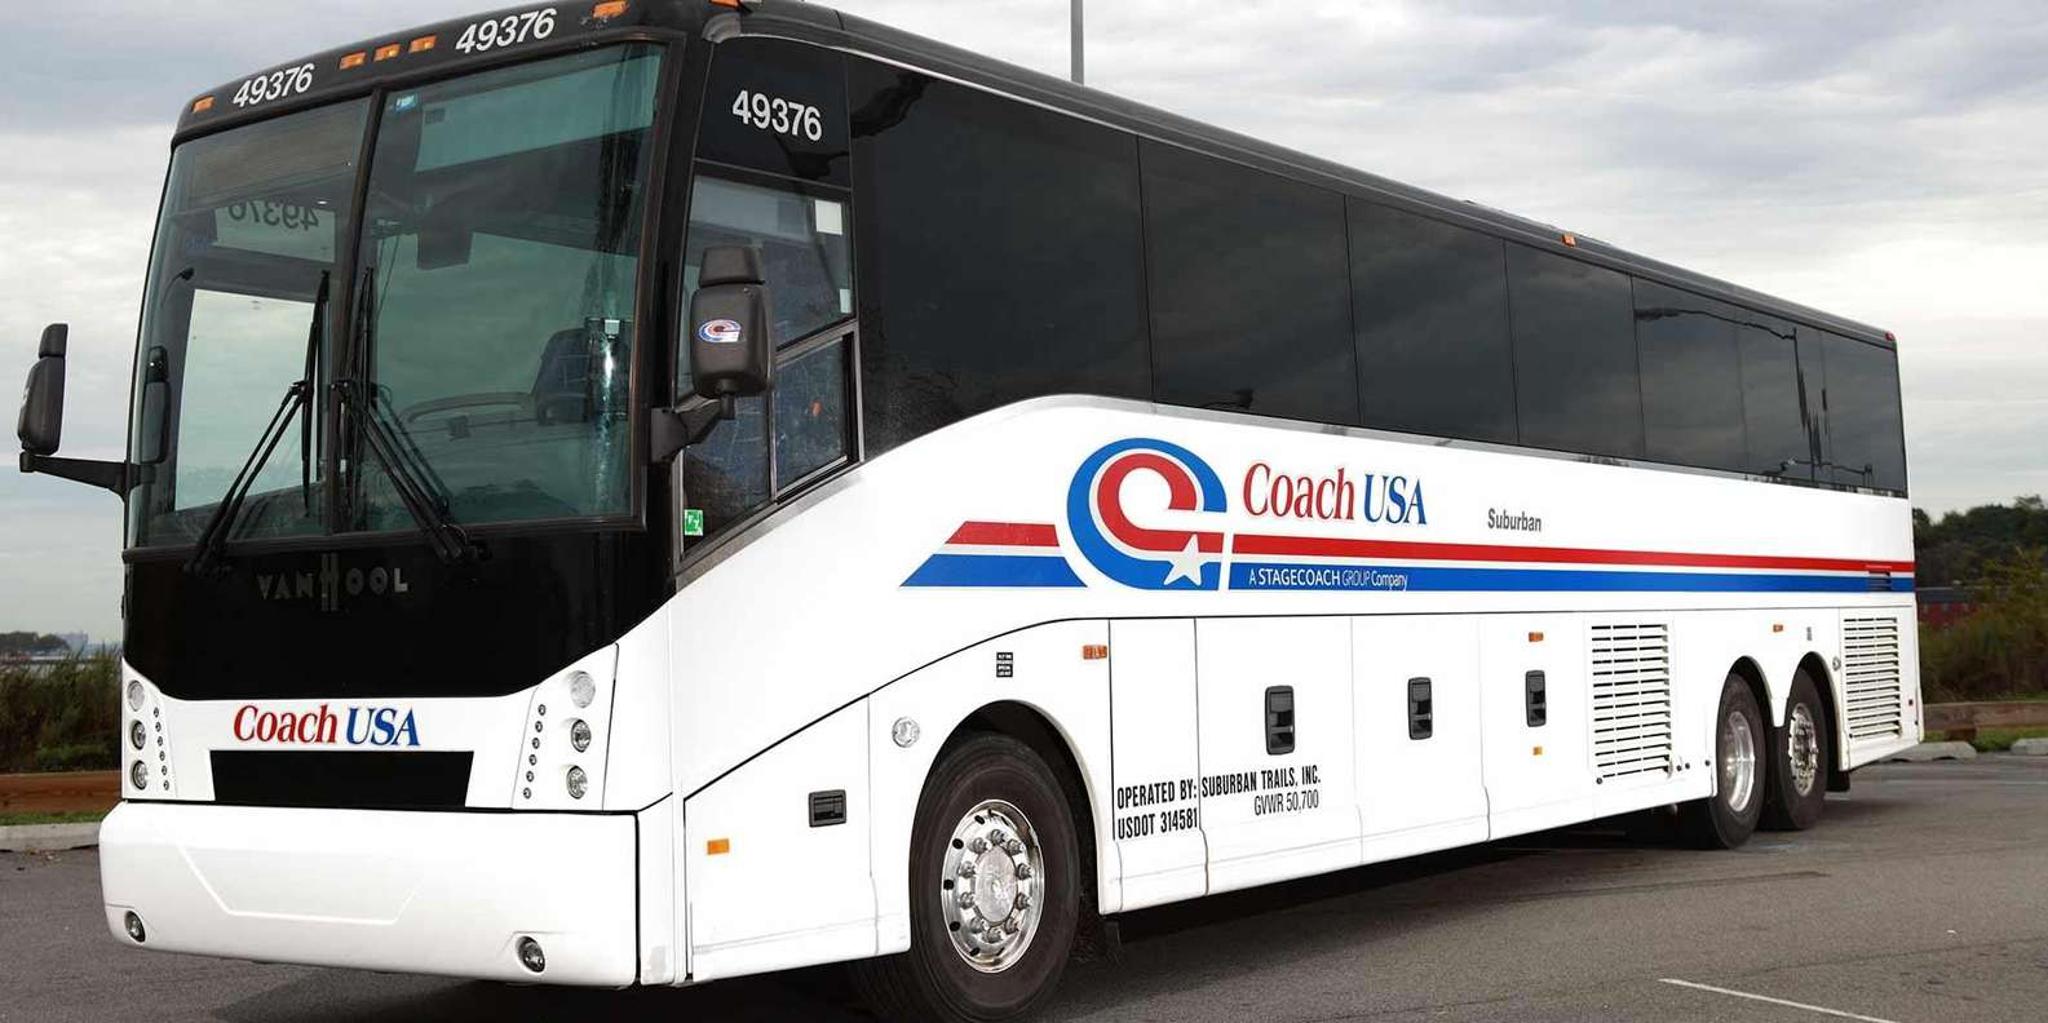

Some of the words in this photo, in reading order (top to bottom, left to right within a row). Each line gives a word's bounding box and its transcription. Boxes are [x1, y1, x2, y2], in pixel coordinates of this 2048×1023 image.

[457, 8, 557, 54] 49376
[233, 63, 315, 108] 49376
[732, 89, 823, 142] 49376
[1243, 463, 1355, 520] Coach
[1364, 474, 1427, 525] USA
[1487, 507, 1542, 532] Suburban
[1249, 569, 1257, 584] A
[1258, 568, 1341, 587] STAGECOACH
[1342, 570, 1370, 587] GROUP
[1371, 571, 1408, 592] Company
[233, 703, 338, 744] Coach
[346, 707, 421, 746] USA
[1117, 781, 1176, 809] OPERATED
[1180, 779, 1197, 799] BY:
[1201, 771, 1257, 798] SUBURBAN
[1301, 764, 1321, 785] INC.
[1254, 793, 1284, 816] GVWR
[1286, 789, 1319, 813] 50,700
[1118, 813, 1156, 840] USDOT
[1160, 807, 1198, 834] 314581
